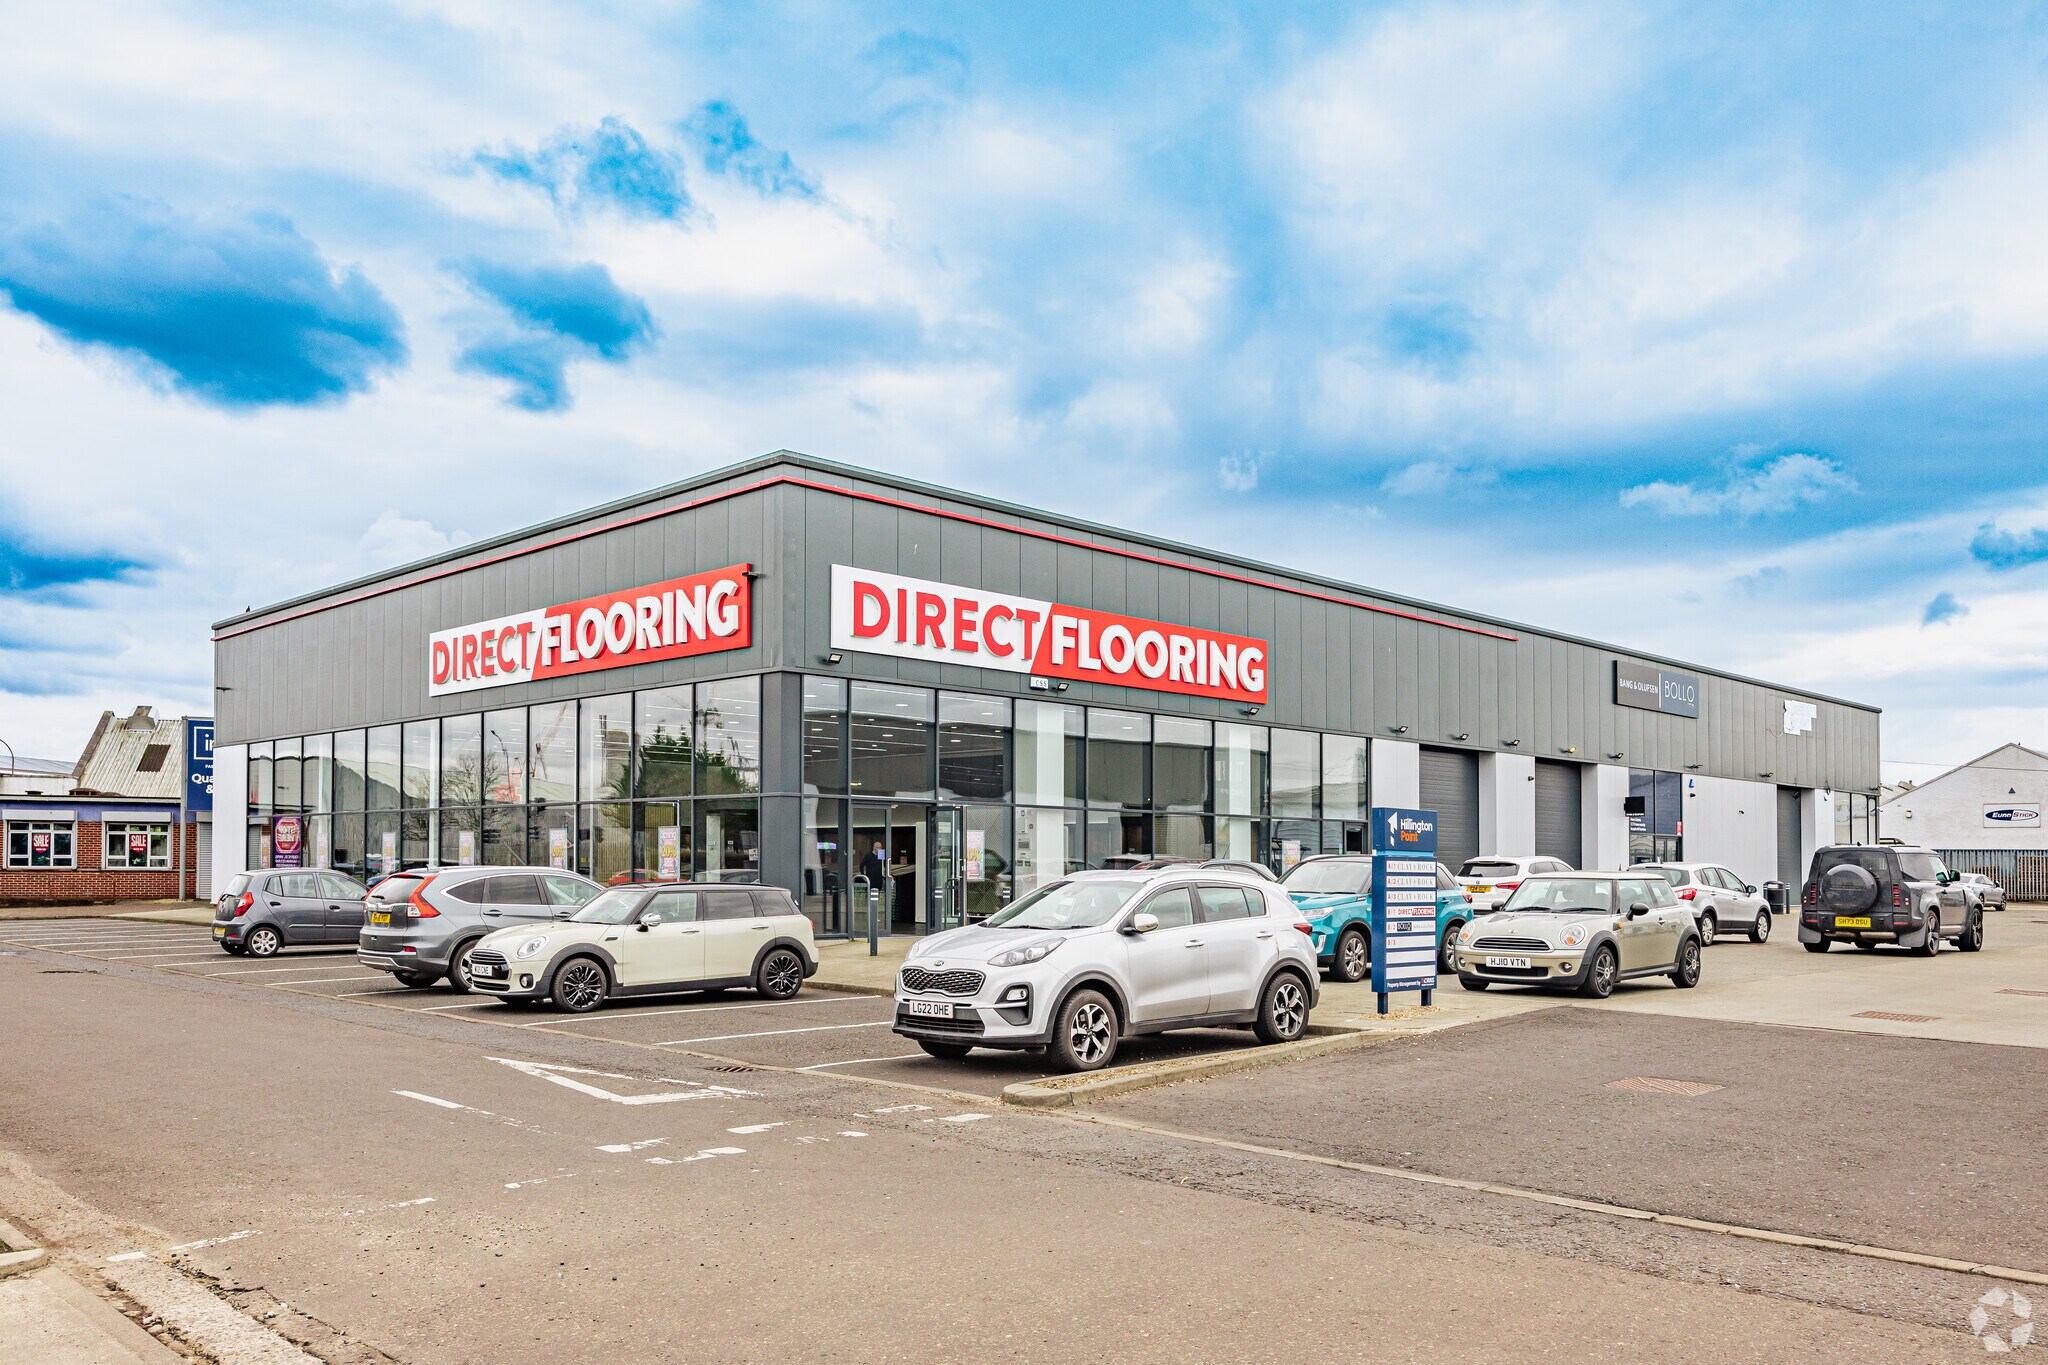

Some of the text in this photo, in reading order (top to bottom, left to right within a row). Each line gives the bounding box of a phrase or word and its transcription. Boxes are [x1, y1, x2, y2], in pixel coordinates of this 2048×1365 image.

[433, 578, 740, 684] DIRECT FLOORING
[851, 580, 1264, 692] DIRECT FLOORING
[1619, 678, 1634, 690] BANG
[1638, 681, 1658, 694] OLUFSEN
[1664, 680, 1695, 703] BOLLO
[33, 834, 49, 847] SALE
[130, 834, 147, 847] SALE
[1400, 830, 1419, 842] Point
[1490, 958, 1526, 967] HJ10 VTN
[912, 1002, 950, 1016] LG22 OHE
